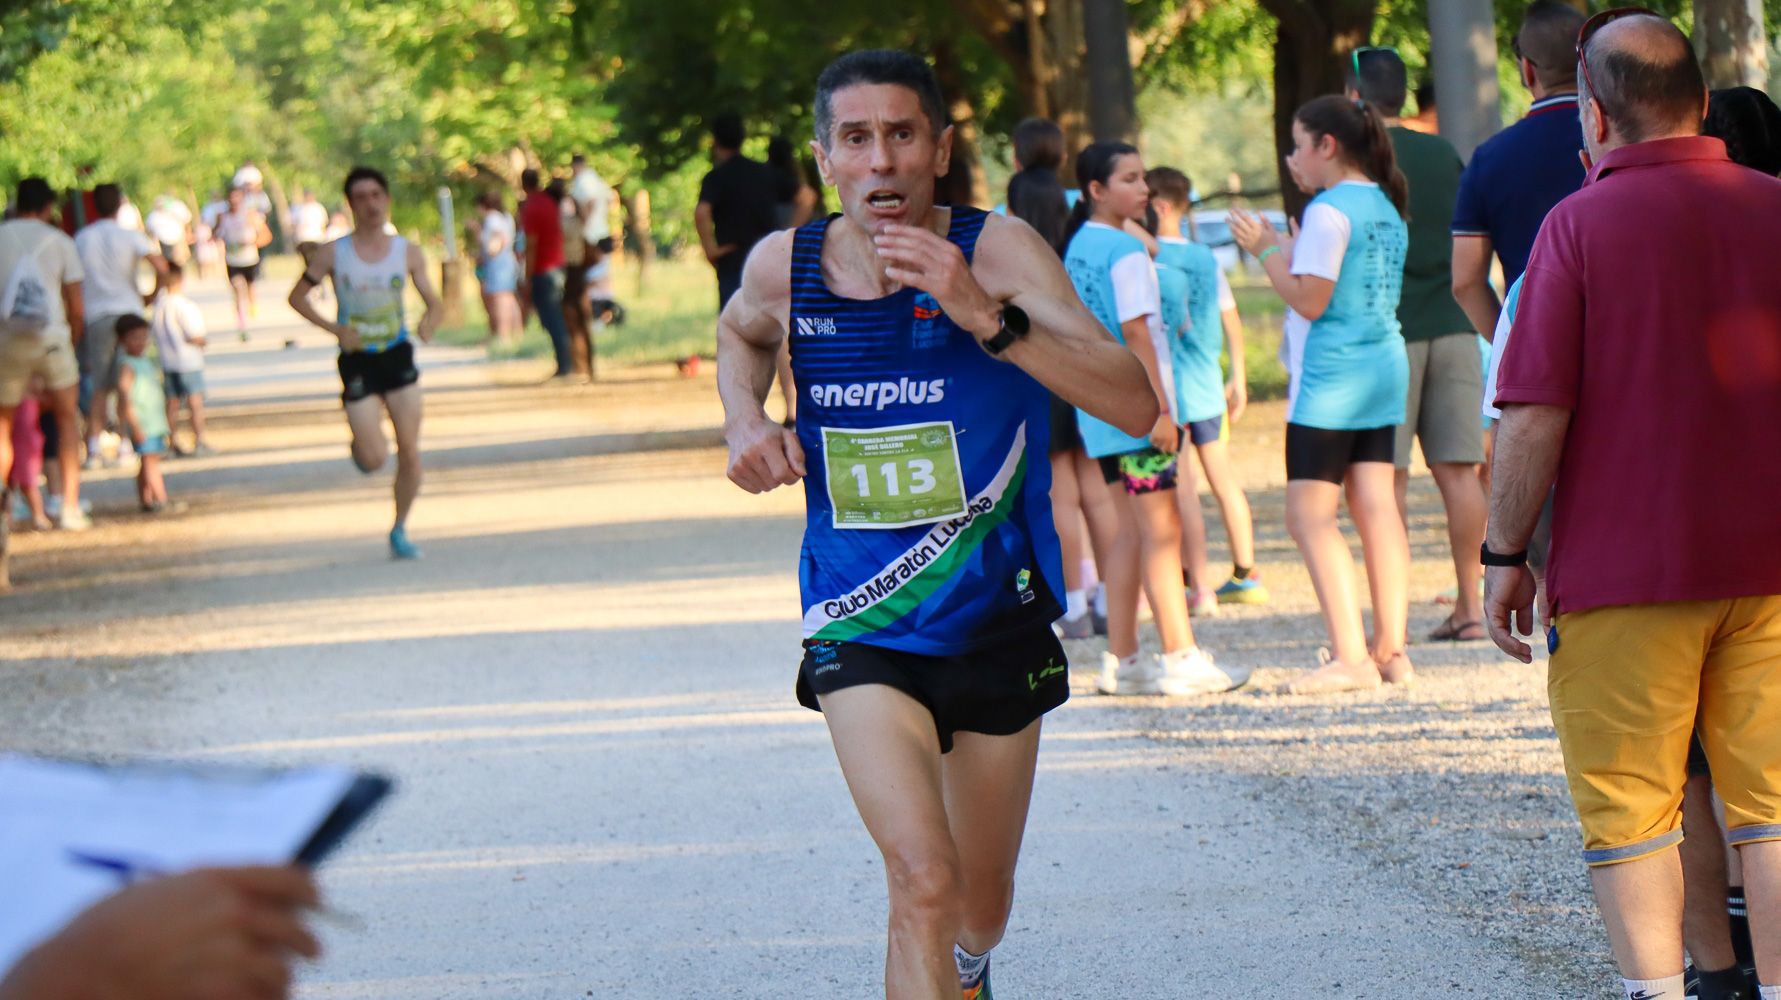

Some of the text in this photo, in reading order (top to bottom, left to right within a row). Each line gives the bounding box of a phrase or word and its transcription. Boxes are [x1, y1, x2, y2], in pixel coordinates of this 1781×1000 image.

[814, 317, 834, 326] RUN
[817, 326, 836, 335] PRO
[810, 377, 945, 410] enerplus
[851, 459, 937, 497] 113
[824, 591, 869, 619] Club
[864, 545, 937, 602] Maratón
